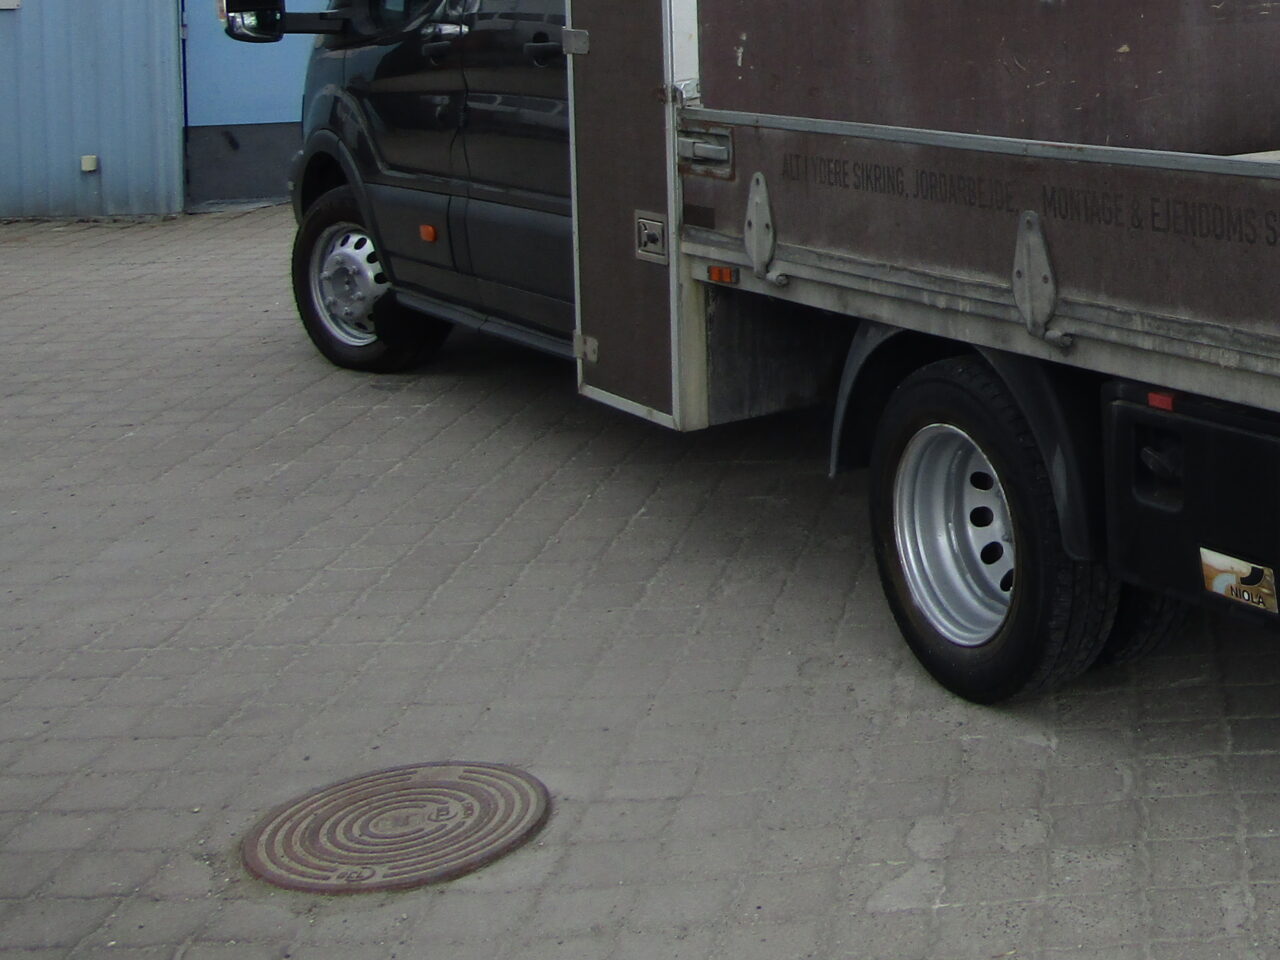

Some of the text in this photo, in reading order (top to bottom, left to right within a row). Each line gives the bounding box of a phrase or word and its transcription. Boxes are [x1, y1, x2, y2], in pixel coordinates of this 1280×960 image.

[1042, 186, 1124, 228] MONTAGE
[1130, 198, 1144, 230] &
[1150, 197, 1257, 246] EJENDOMS
[1230, 585, 1266, 607] NIOLA
